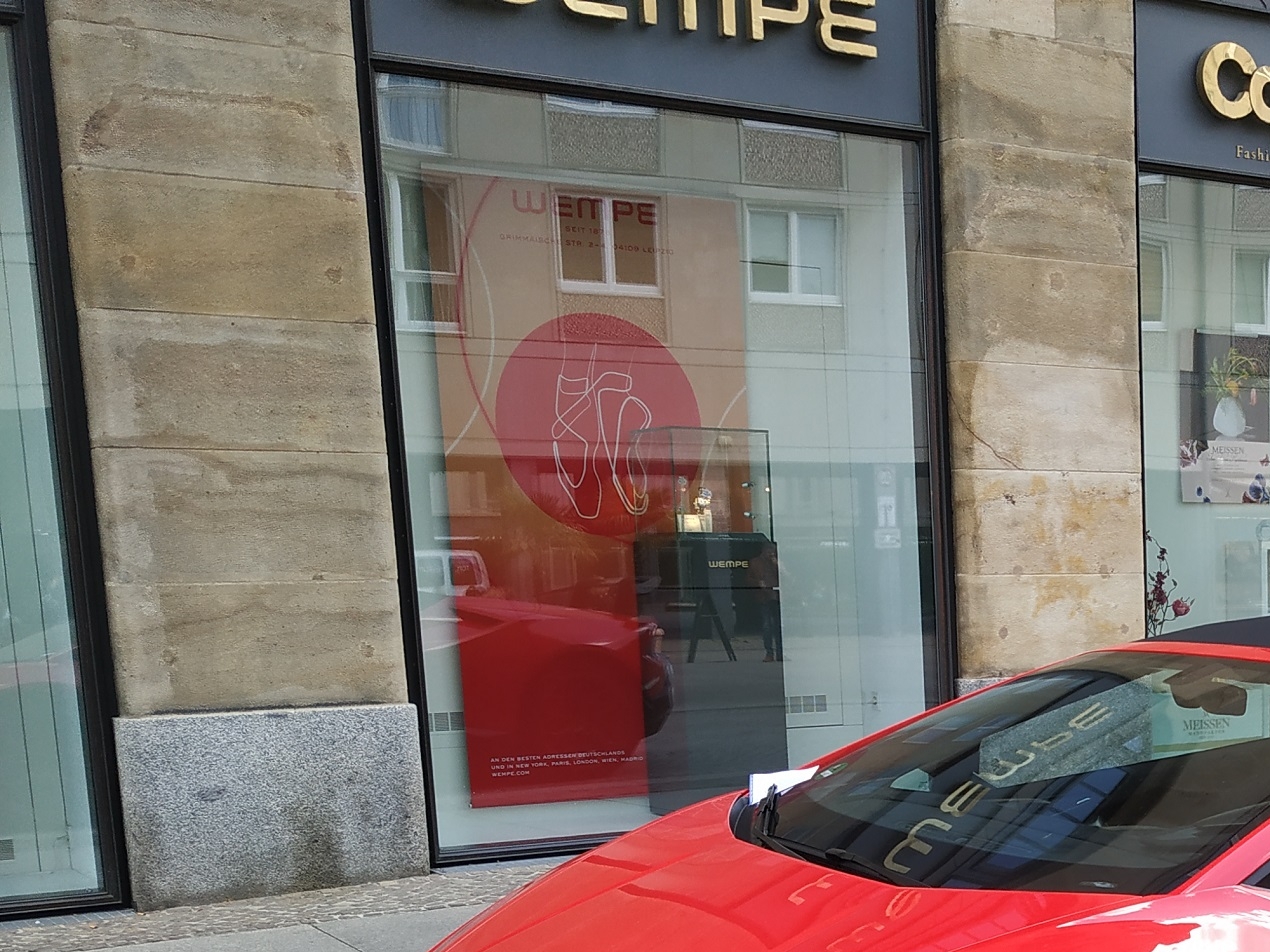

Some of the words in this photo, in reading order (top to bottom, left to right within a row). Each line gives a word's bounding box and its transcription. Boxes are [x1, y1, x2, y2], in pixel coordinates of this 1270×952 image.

[512, 189, 657, 226] WEMPE
[1212, 446, 1244, 454] MEISSEN
[708, 560, 749, 568] WEMPE
[1183, 718, 1231, 732] MEISSEN
[542, 752, 576, 760] ADRESSEN
[578, 750, 625, 758] DEUTSCHLANDS
